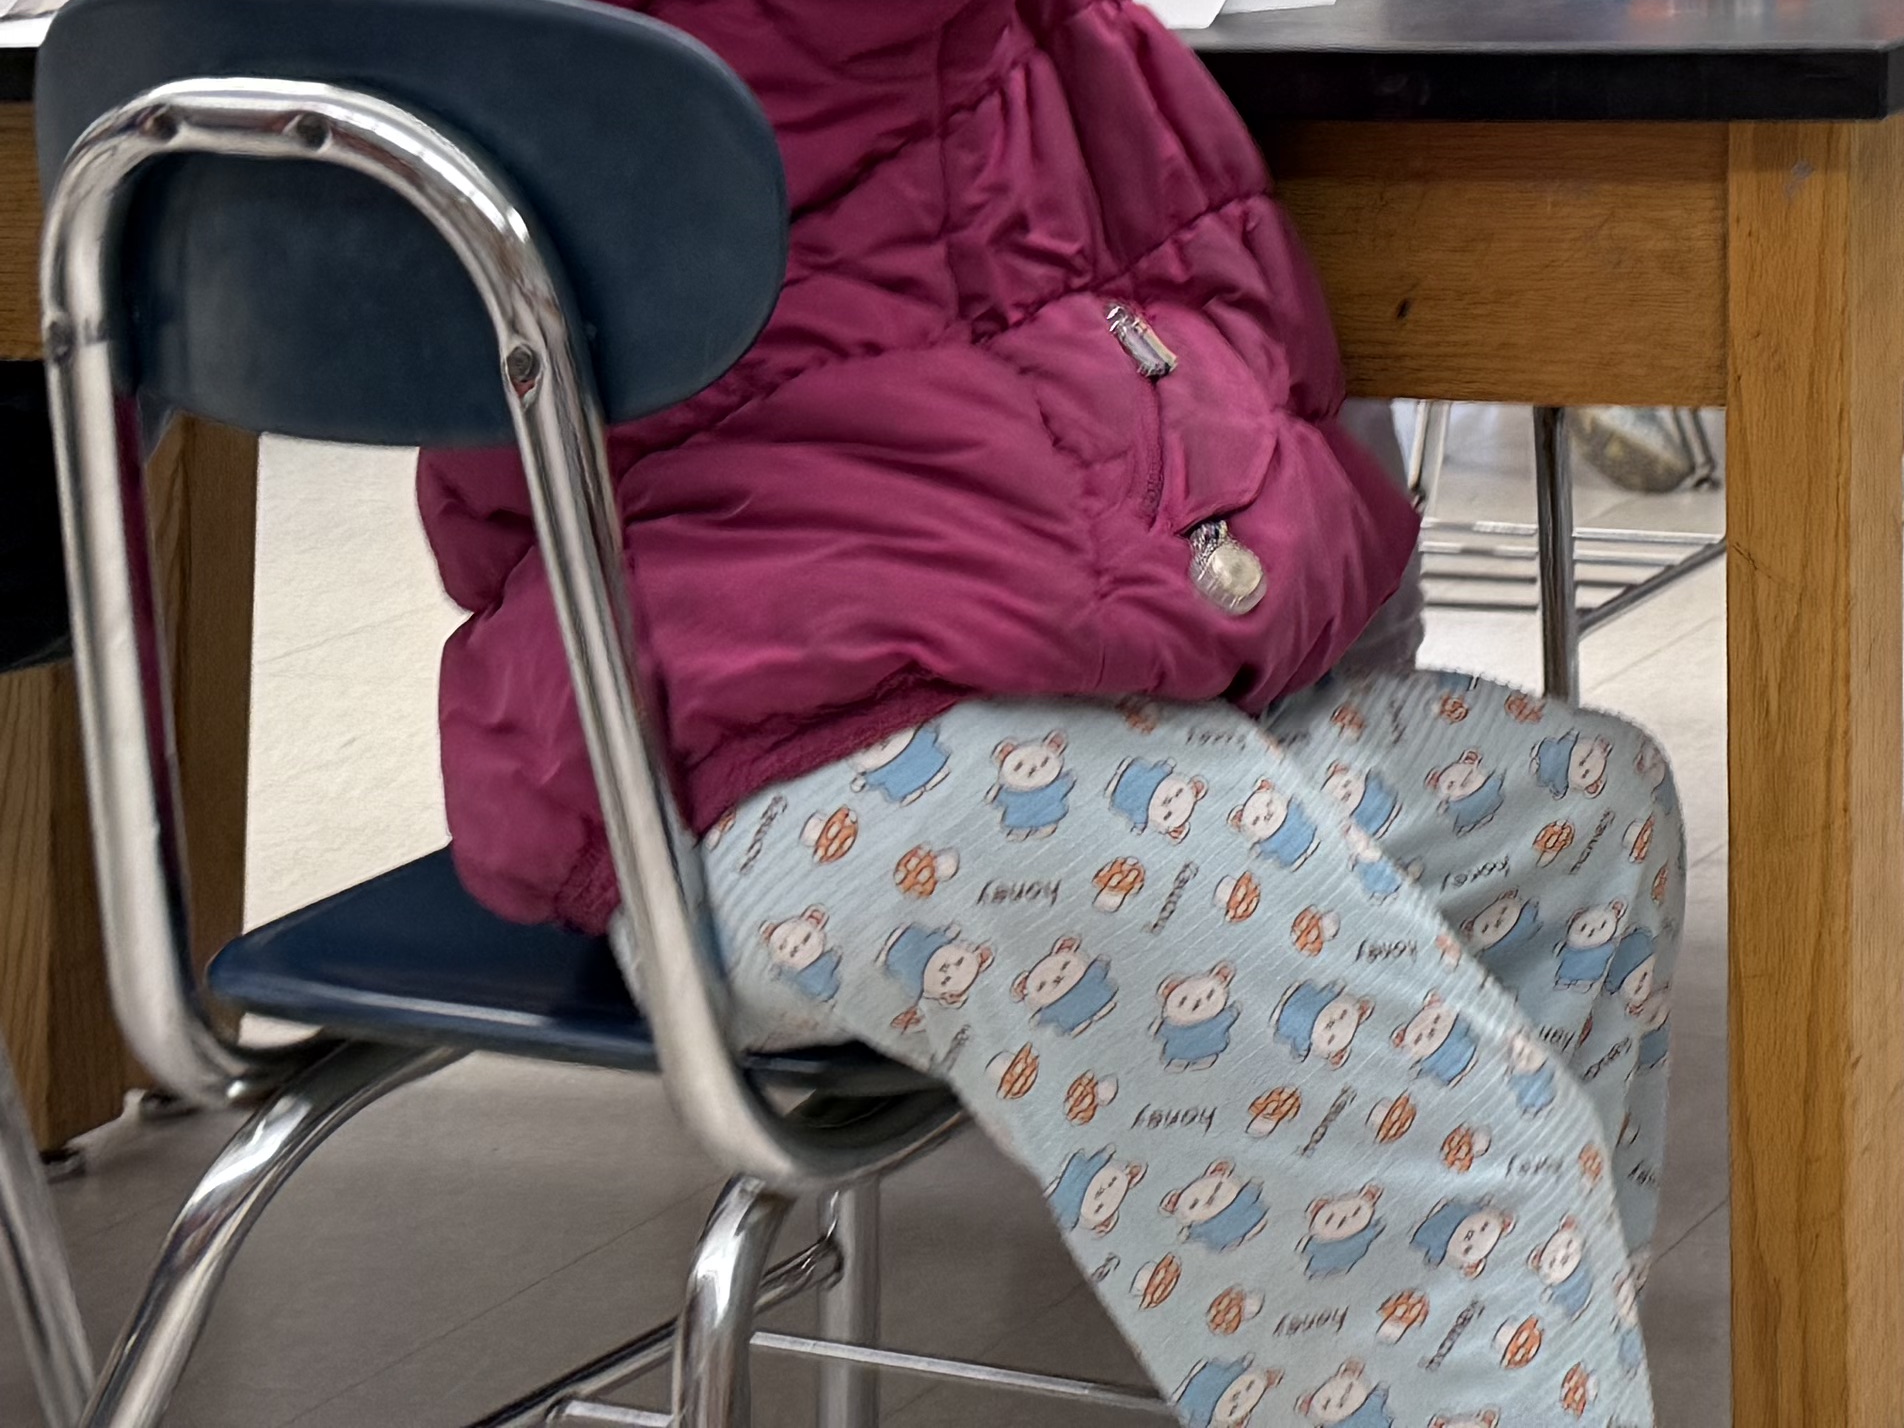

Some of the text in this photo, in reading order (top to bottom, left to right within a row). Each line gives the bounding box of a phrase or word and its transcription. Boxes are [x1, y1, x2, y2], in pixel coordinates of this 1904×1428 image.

[976, 877, 1062, 907] honey
[1131, 1102, 1218, 1138] honey
[1273, 1304, 1349, 1337] honey
